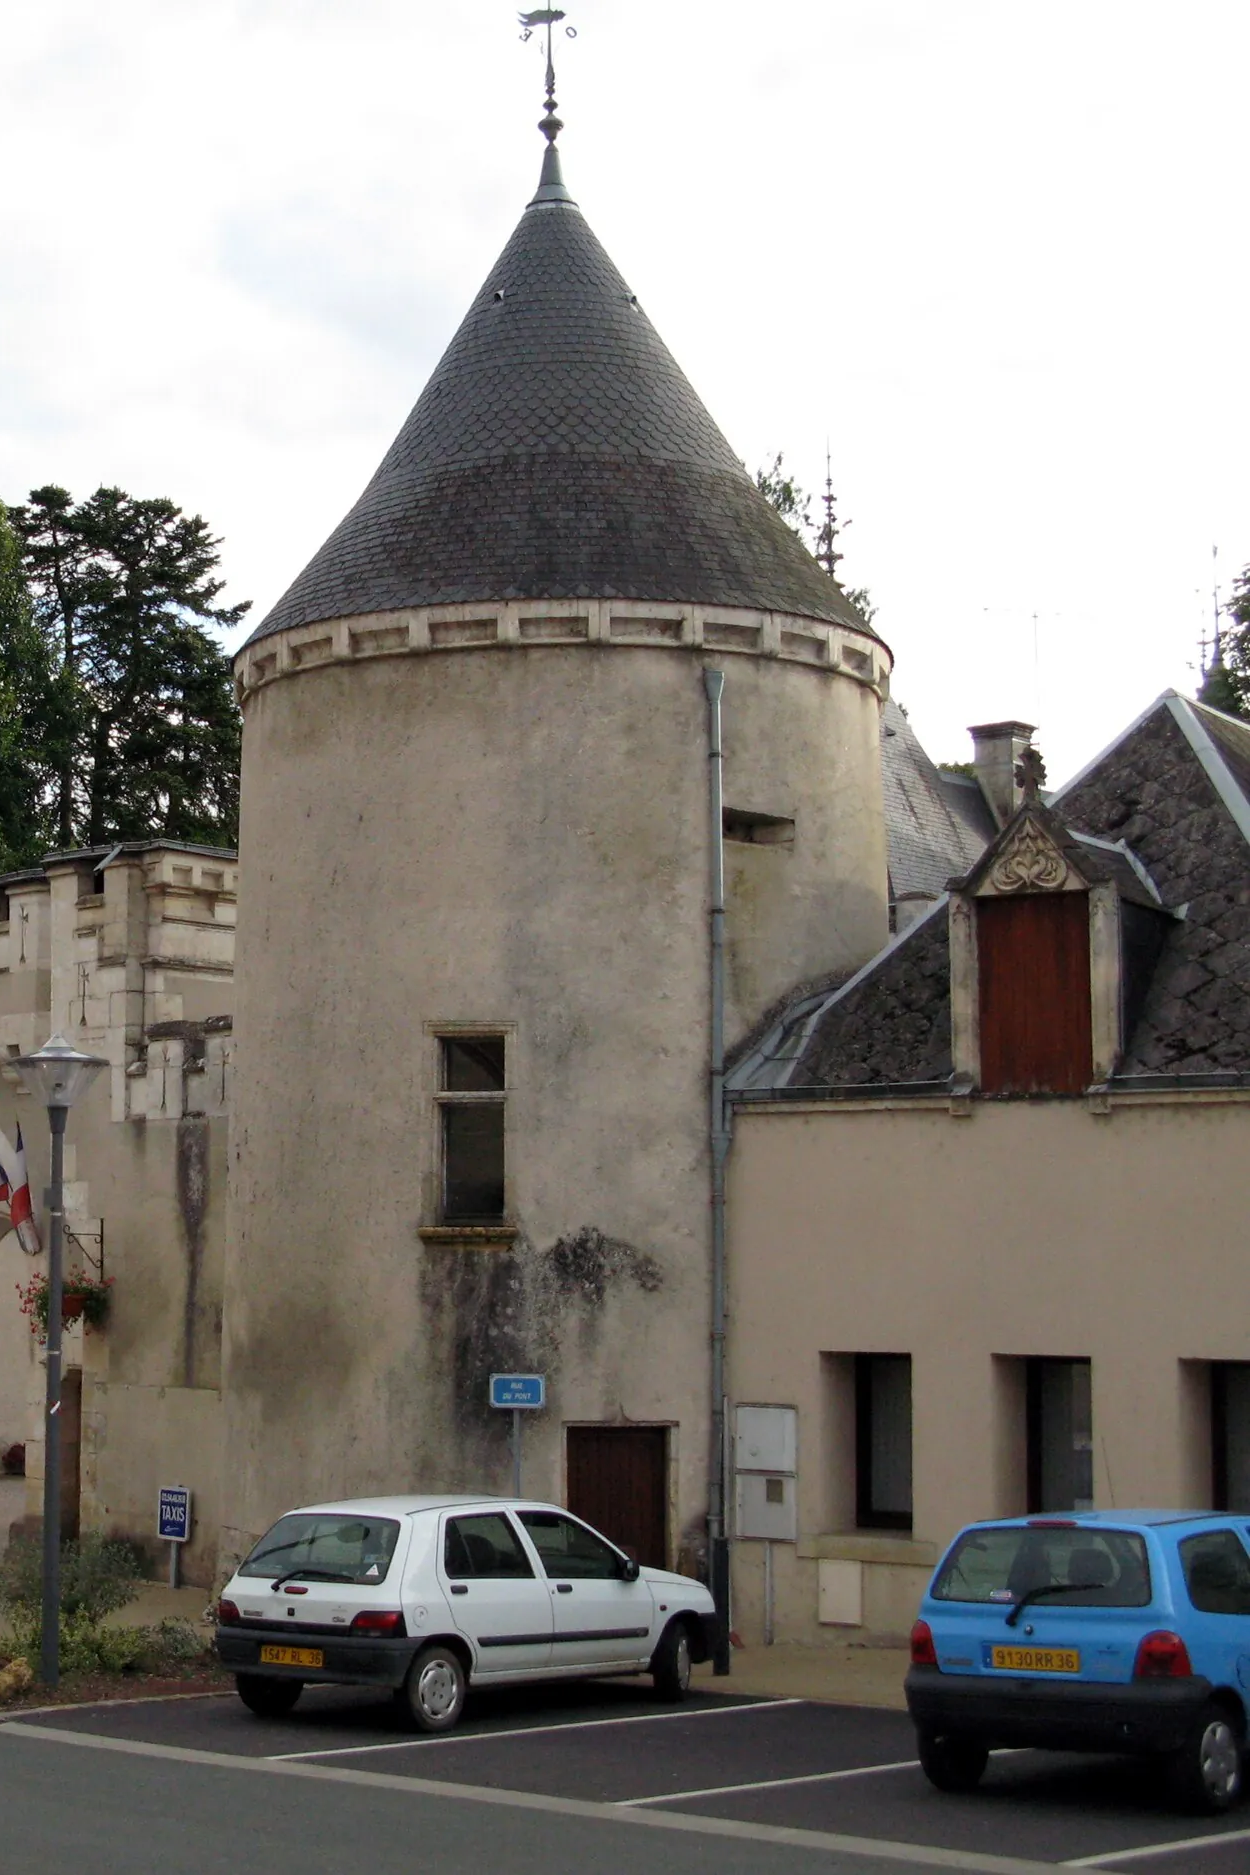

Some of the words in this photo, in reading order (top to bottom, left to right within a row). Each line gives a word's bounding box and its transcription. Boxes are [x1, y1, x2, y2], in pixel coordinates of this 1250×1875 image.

[502, 1392, 511, 1400] DU
[514, 1392, 531, 1400] PONT
[161, 1505, 185, 1522] TAXIS
[263, 1647, 288, 1662] 1547
[291, 1648, 303, 1663] RL
[308, 1650, 321, 1665] 36
[996, 1650, 1032, 1667] 9130
[1035, 1652, 1054, 1668] RR
[1056, 1653, 1075, 1669] 36
